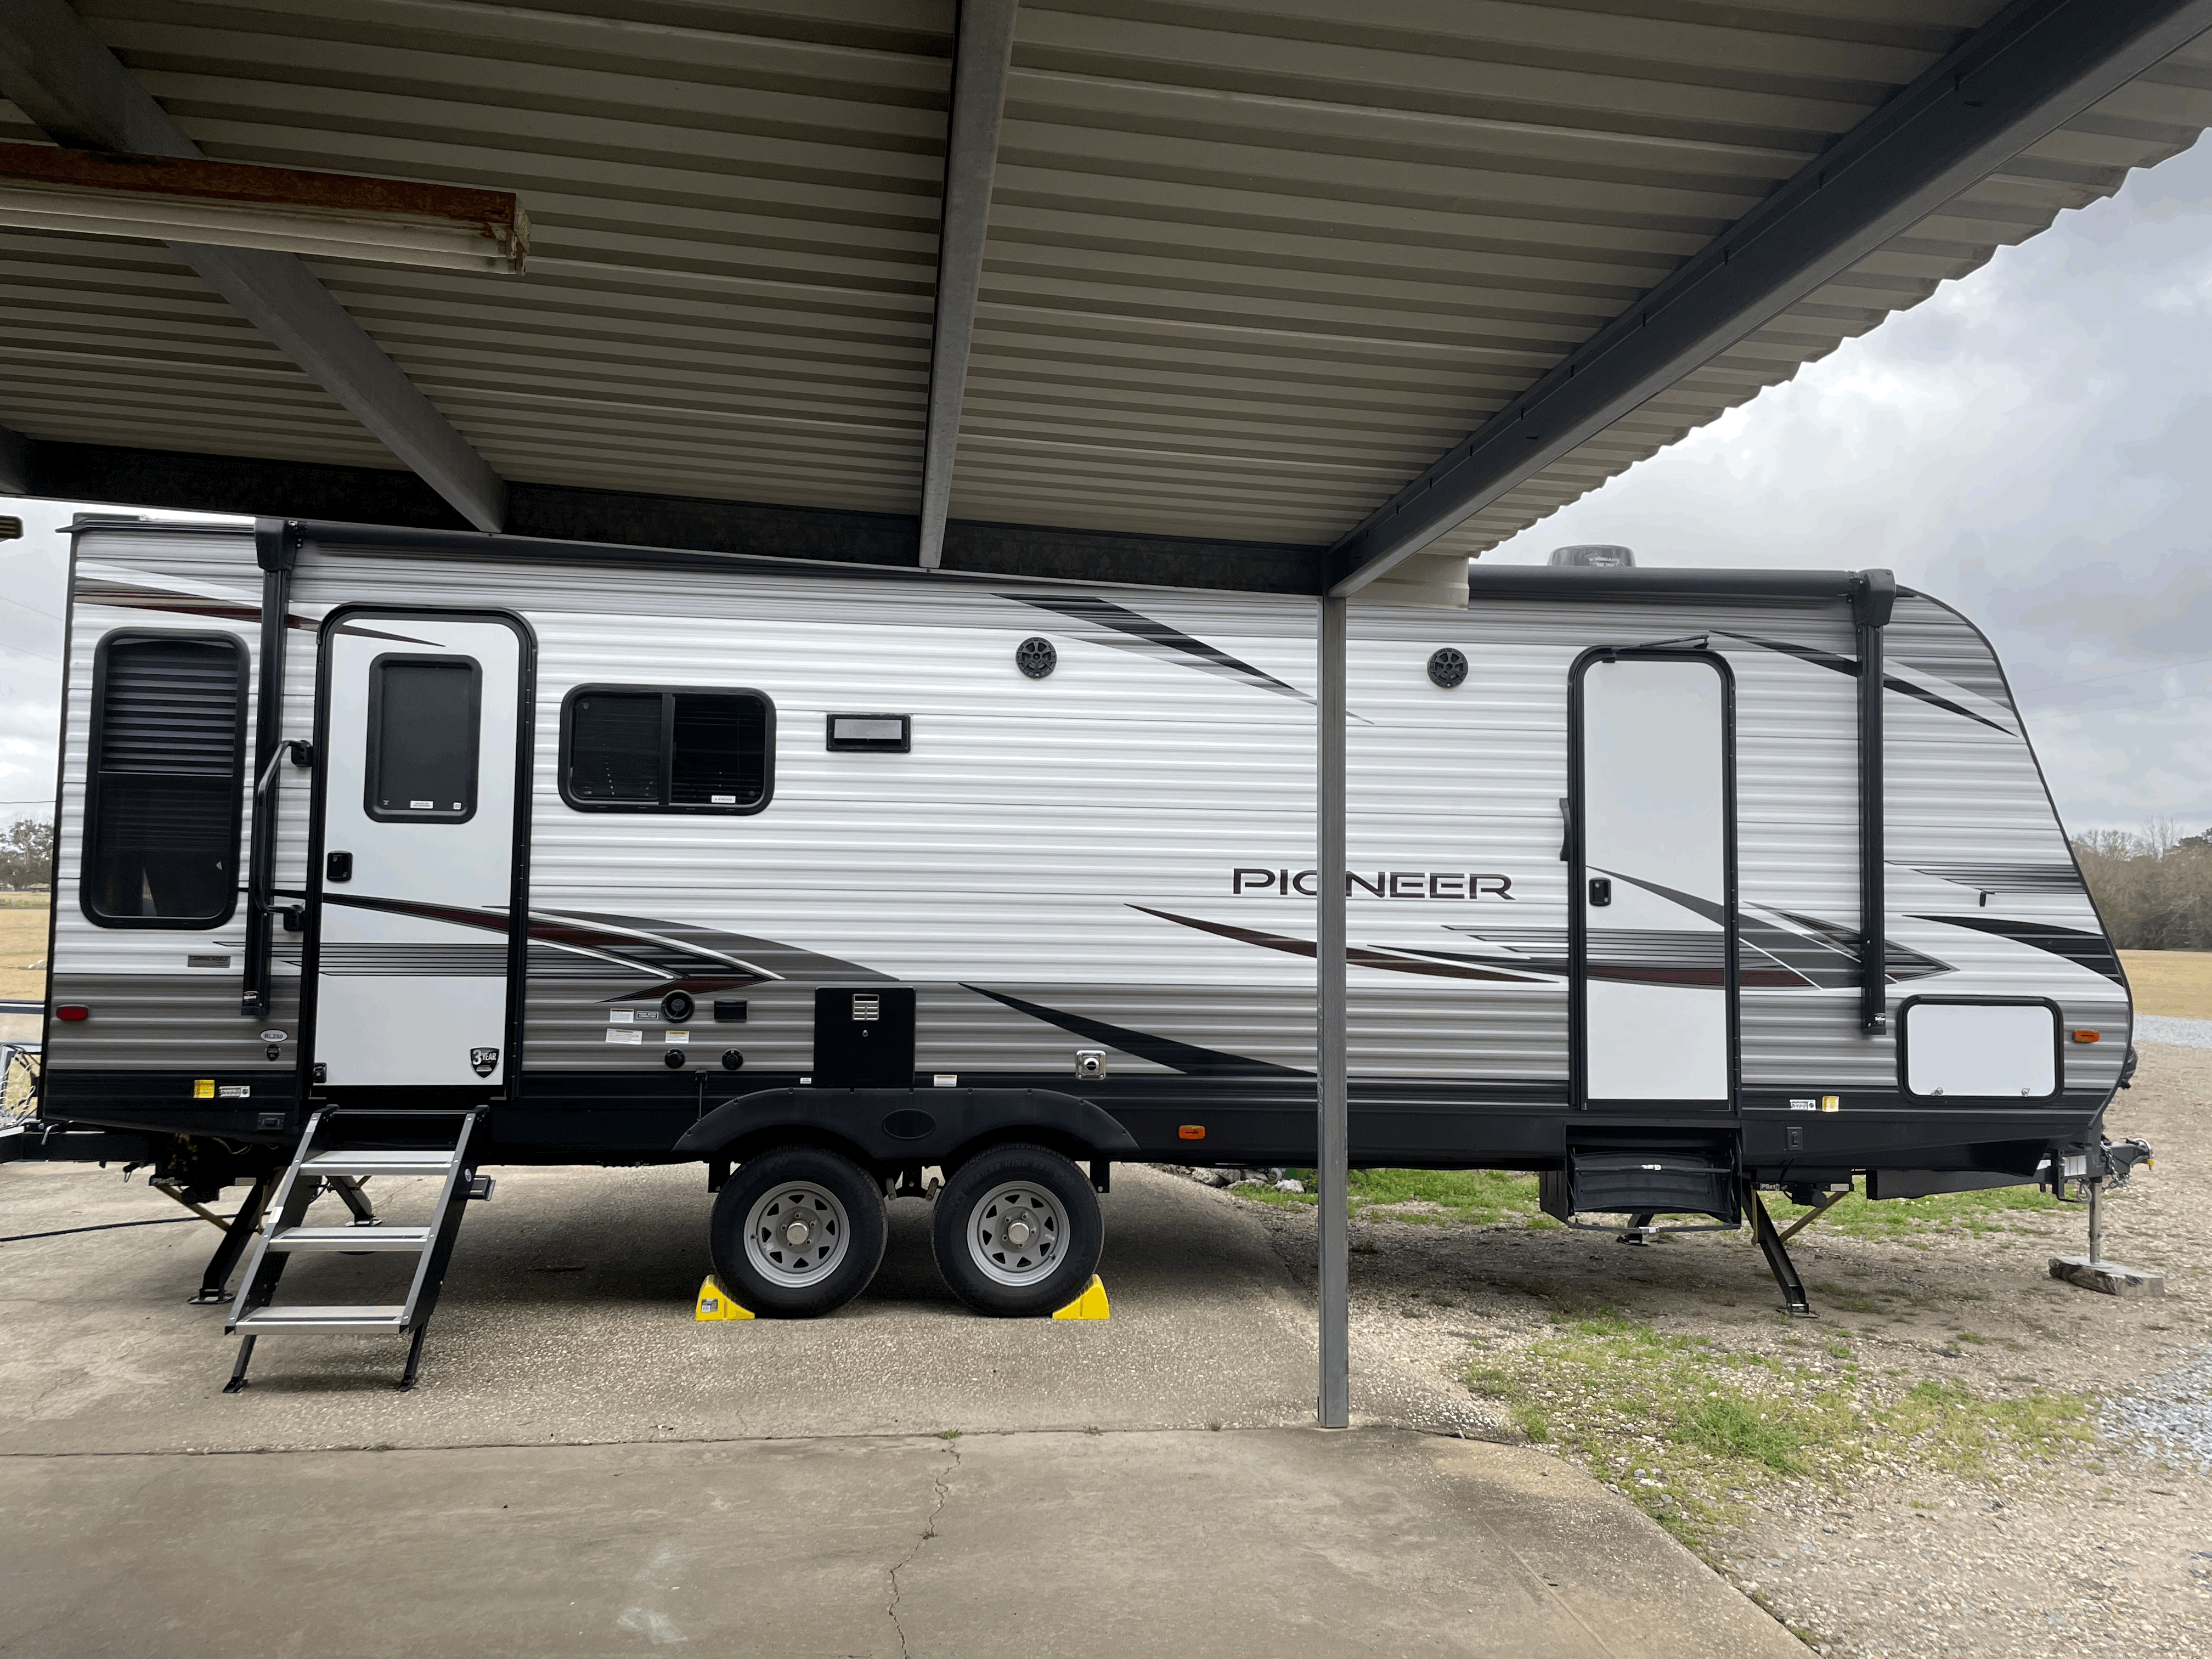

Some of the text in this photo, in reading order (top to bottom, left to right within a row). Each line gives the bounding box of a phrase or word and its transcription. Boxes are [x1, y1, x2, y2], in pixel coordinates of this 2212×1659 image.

[1233, 868, 1516, 900] PIONEER
[472, 1049, 496, 1065] 3 YEAR
[1005, 1159, 1029, 1167] KING
